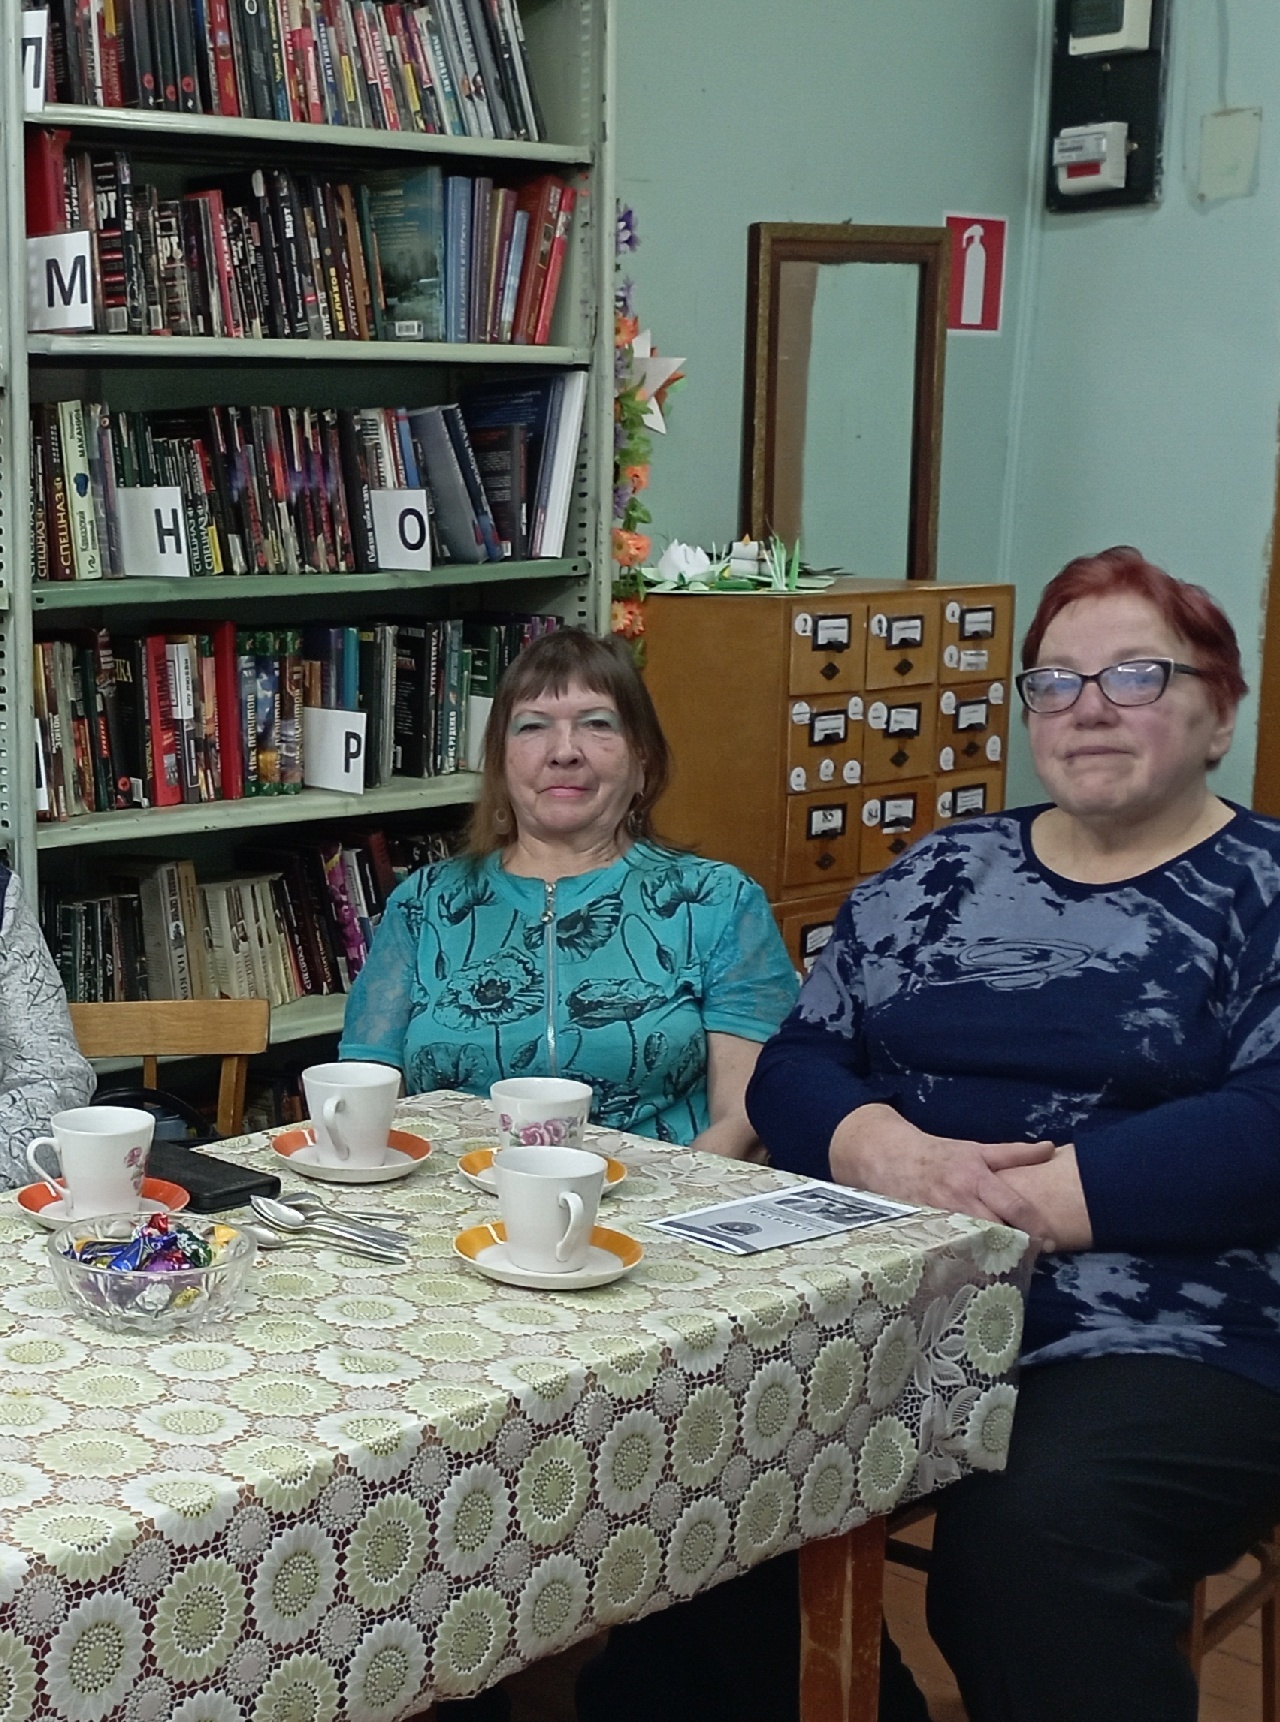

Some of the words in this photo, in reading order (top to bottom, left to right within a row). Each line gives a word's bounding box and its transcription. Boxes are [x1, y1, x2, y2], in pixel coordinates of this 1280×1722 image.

[21, 37, 42, 88] Л
[44, 254, 88, 308] М
[56, 491, 72, 567] СПЕЦНАЗ
[153, 508, 182, 554] Н
[398, 507, 427, 551] О
[344, 731, 361, 774] Р
